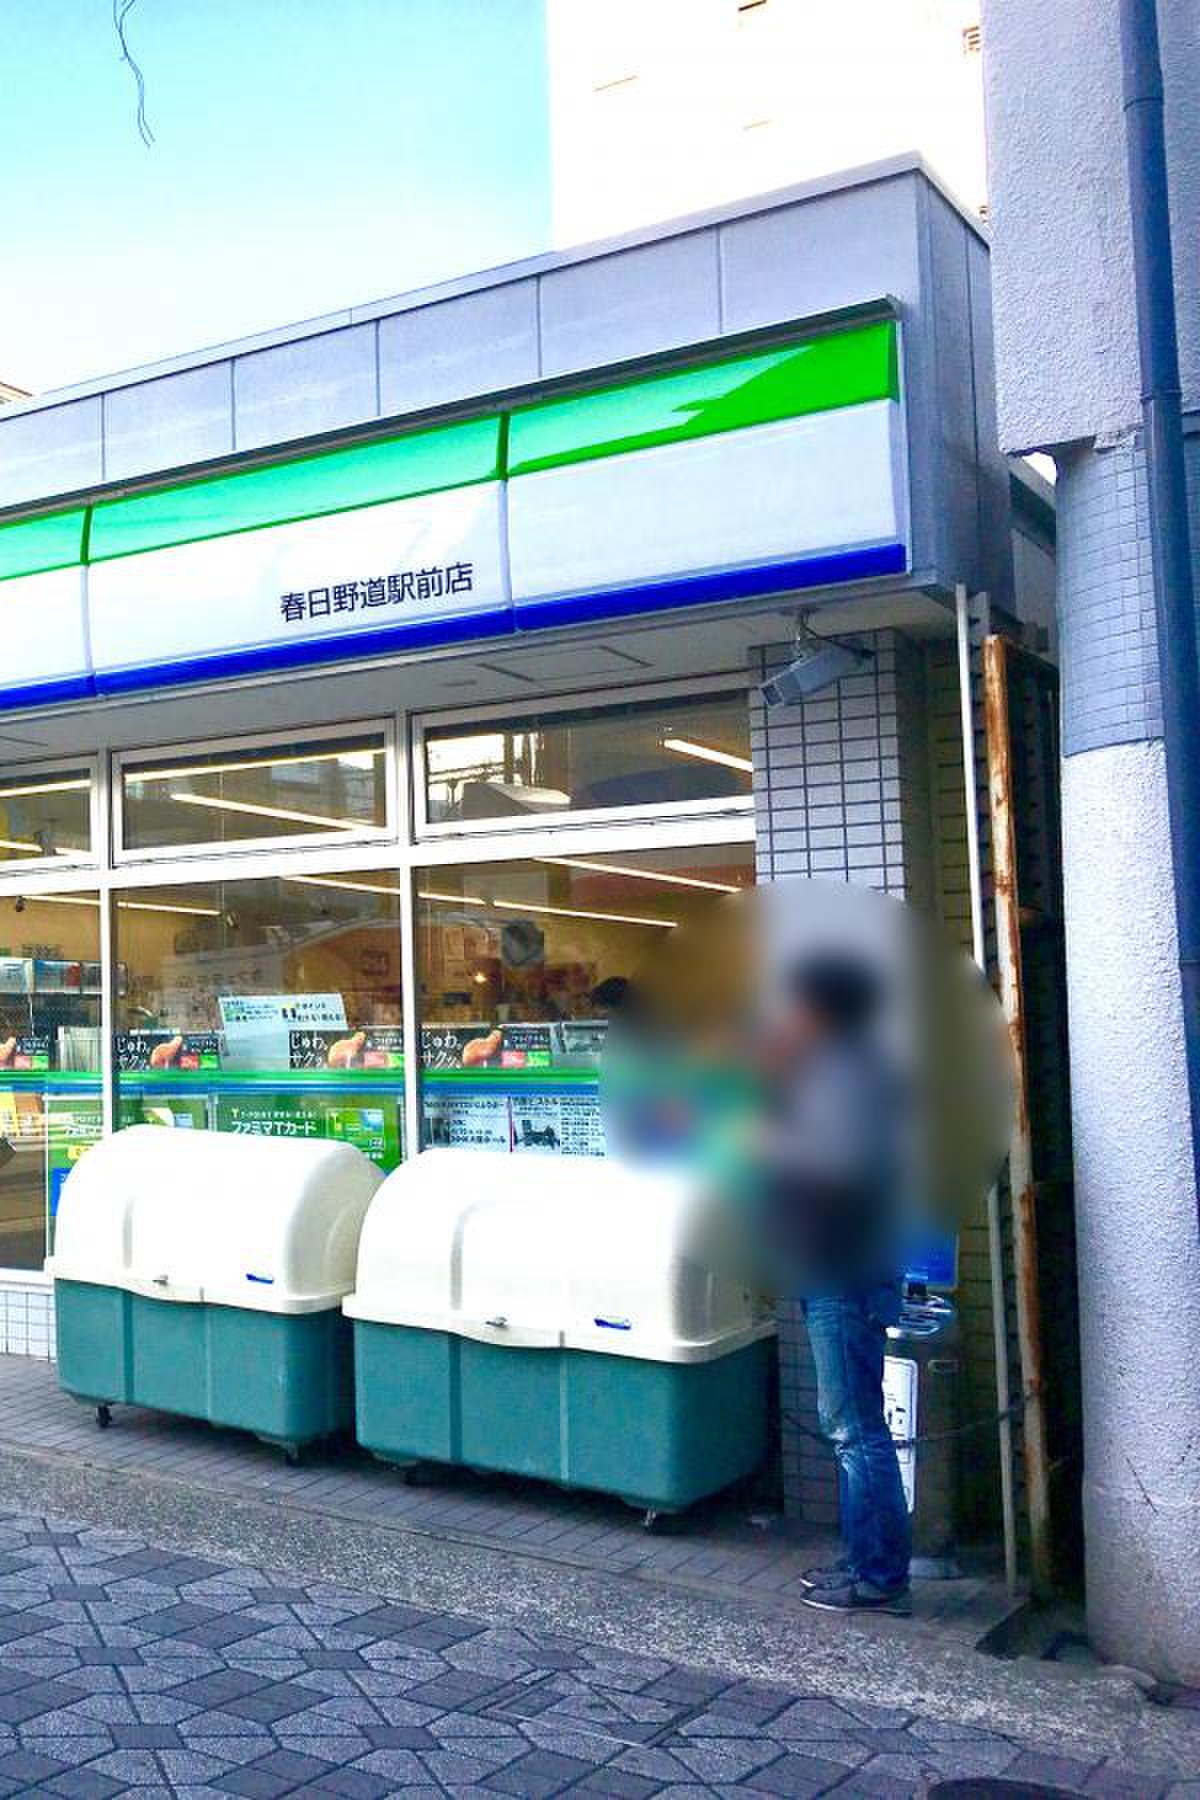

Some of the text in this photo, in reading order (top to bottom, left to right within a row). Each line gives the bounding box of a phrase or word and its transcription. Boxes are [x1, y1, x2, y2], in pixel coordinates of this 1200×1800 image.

[280, 562, 473, 622] 春日野道駅前店
